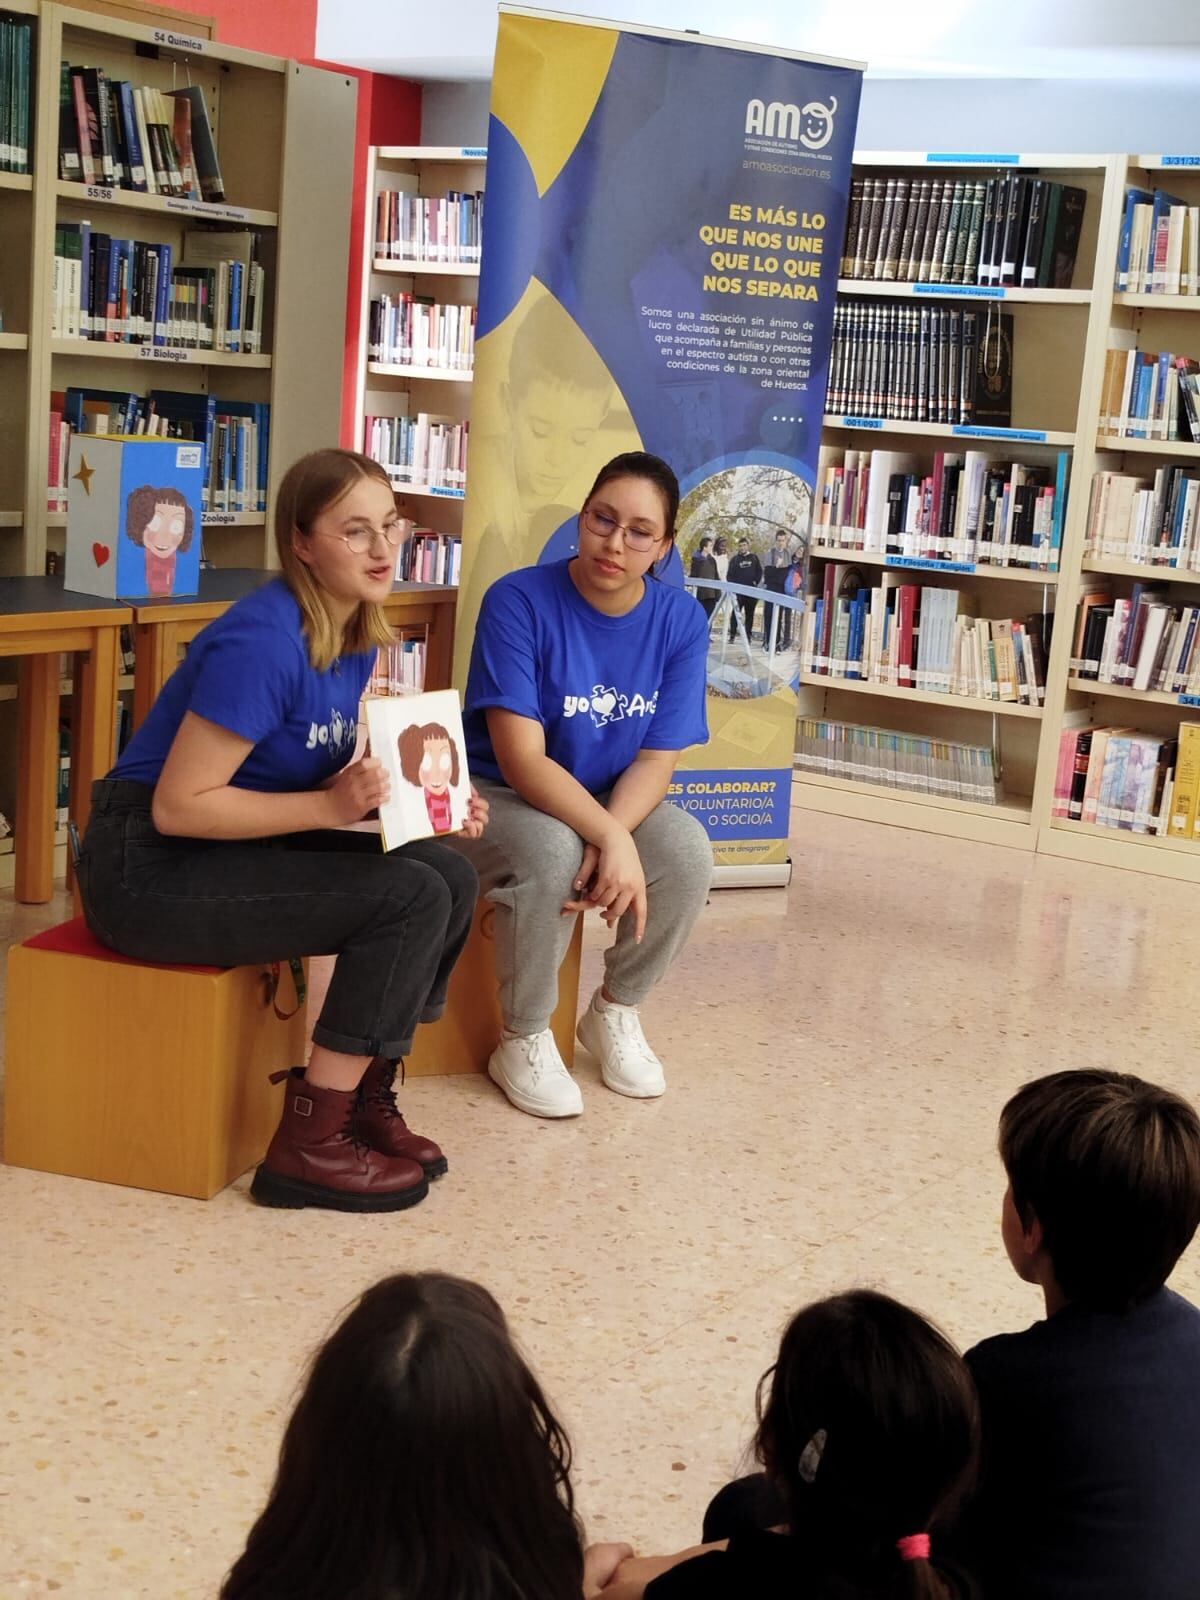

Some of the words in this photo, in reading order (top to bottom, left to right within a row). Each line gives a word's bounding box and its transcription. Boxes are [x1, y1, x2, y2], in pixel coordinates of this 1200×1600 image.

[154, 32, 165, 42] 54
[743, 160, 832, 180] amoasociacion.es
[729, 204, 751, 222] ES
[756, 206, 797, 226] MÁS
[802, 213, 825, 230] LO
[700, 226, 738, 246] QUE
[742, 230, 782, 250] NOS
[787, 236, 824, 254] UNE
[711, 252, 750, 272] QUE
[754, 256, 779, 273] LO
[783, 259, 821, 278] QUE
[703, 276, 742, 294] NOS
[746, 279, 819, 302] SEPARA
[641, 306, 672, 318] Somos
[677, 311, 695, 320] una
[700, 312, 746, 325] asociación
[751, 317, 764, 326] sin
[770, 318, 798, 329] ánimo
[803, 320, 814, 330] de
[648, 320, 672, 330] lucro
[676, 322, 720, 335] declarada
[724, 326, 736, 336] de
[741, 328, 776, 340] Utilidad
[781, 330, 813, 343] Pública
[141, 348, 151, 357] 57
[655, 334, 673, 345] que
[674, 336, 721, 348] acompaña
[730, 339, 764, 351] familias
[766, 344, 772, 353] y
[772, 344, 812, 356] personas
[661, 348, 672, 356] en
[676, 346, 684, 356] el
[686, 349, 726, 362] espectro
[728, 352, 758, 362] autista
[770, 356, 787, 365] con
[789, 356, 811, 367] otras
[666, 360, 720, 372] condiciones
[724, 362, 736, 373] de
[739, 364, 748, 374] la
[751, 367, 773, 376] zona
[776, 368, 810, 379] oriental
[760, 378, 773, 389] de
[774, 380, 808, 391] Huesca.
[563, 696, 592, 718] yo
[306, 721, 328, 749] yo
[687, 782, 777, 794] COLABORAR?
[682, 798, 775, 810] VOLUNTARIO/A
[708, 814, 718, 826] O
[721, 813, 773, 826] SOCIO/A
